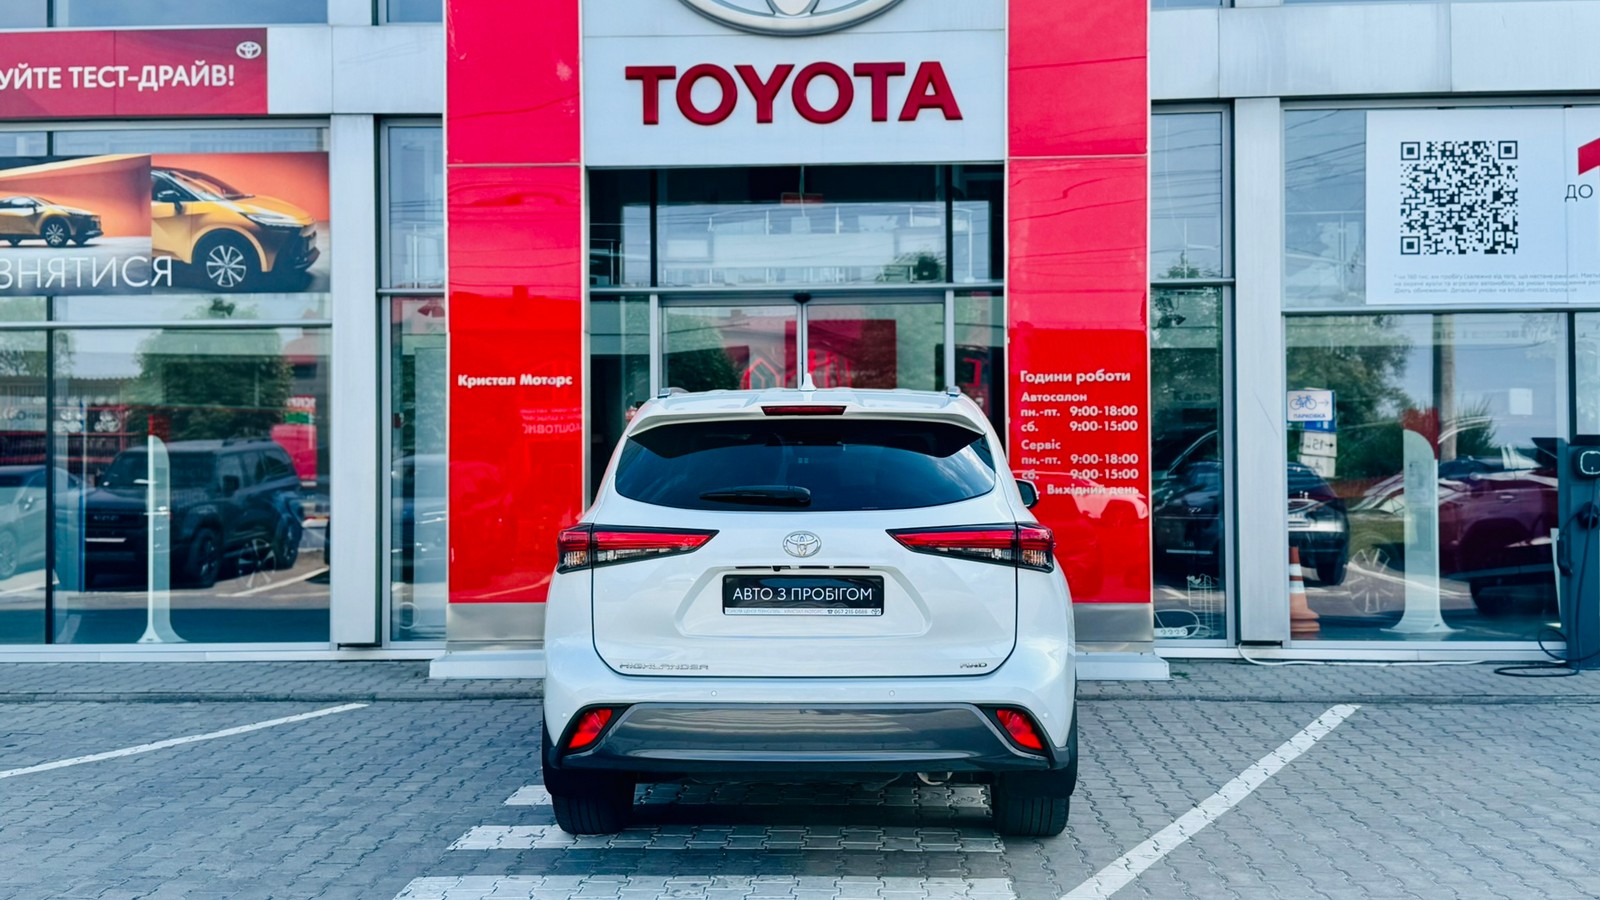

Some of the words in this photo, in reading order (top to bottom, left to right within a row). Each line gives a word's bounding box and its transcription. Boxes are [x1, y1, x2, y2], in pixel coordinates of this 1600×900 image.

[68, 60, 235, 92] ТЕСТ-ДРАЙВ!
[625, 61, 963, 126] TOYOTA
[1564, 183, 1594, 203] ДО
[458, 374, 516, 389] Кристал
[520, 373, 573, 388] Моторс
[1020, 370, 1073, 384] Години
[1076, 368, 1131, 385] роботи
[1021, 391, 1088, 402] Автосалон
[1020, 408, 1061, 417] пн.-пт.
[1020, 421, 1039, 432] сб.
[1021, 438, 1061, 453] Сервіс
[1021, 456, 1061, 465] пн.-пт.
[1021, 469, 1040, 480] сб.
[1046, 483, 1106, 497] Вихідний
[1109, 486, 1139, 497] день
[732, 587, 773, 601] АВТО
[777, 587, 787, 601] З
[791, 587, 873, 601] ПРОБІГОМ
[619, 663, 709, 671] HIGHLANDER
